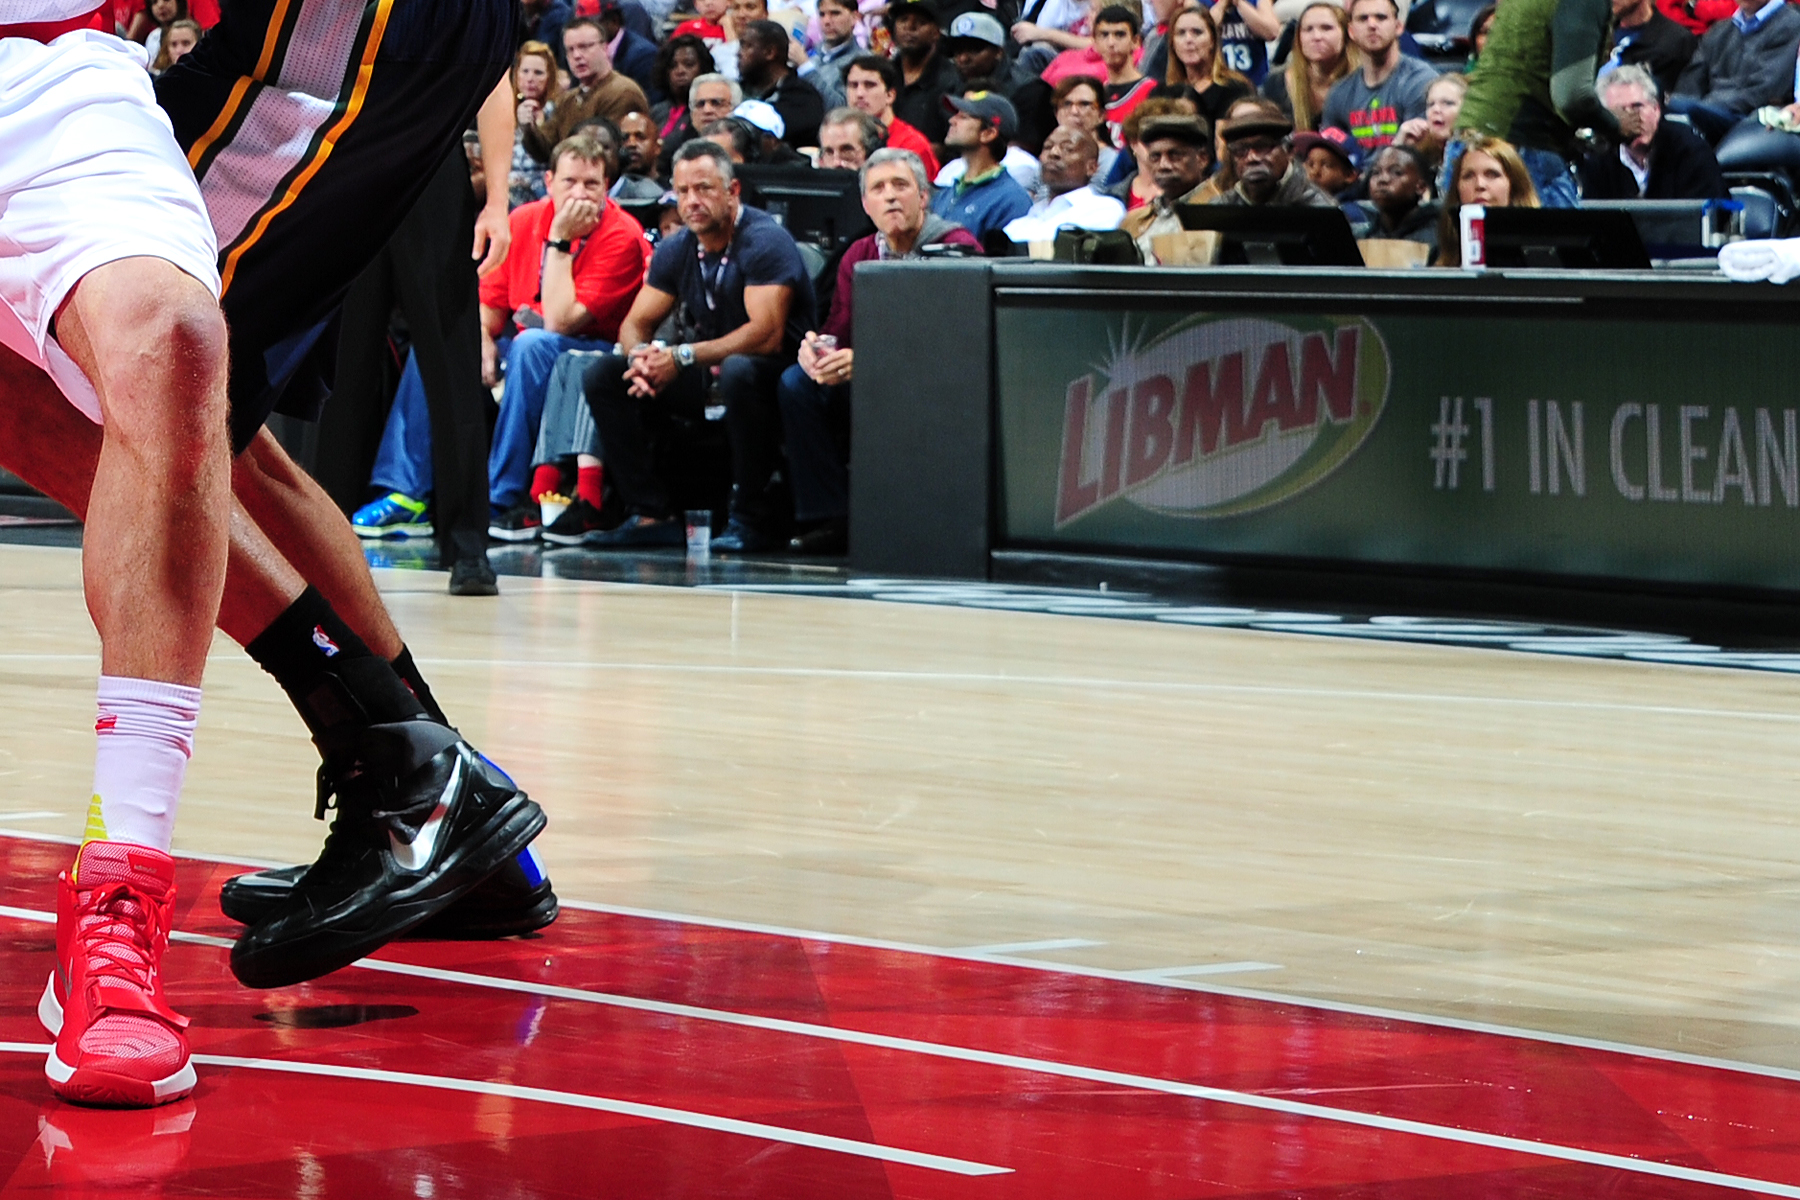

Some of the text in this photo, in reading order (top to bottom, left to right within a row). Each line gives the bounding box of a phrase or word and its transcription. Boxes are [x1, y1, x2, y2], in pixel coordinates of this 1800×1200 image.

[1221, 43, 1253, 71] 13
[1054, 325, 1800, 531] LIBMAN #1 IN CLEAN
